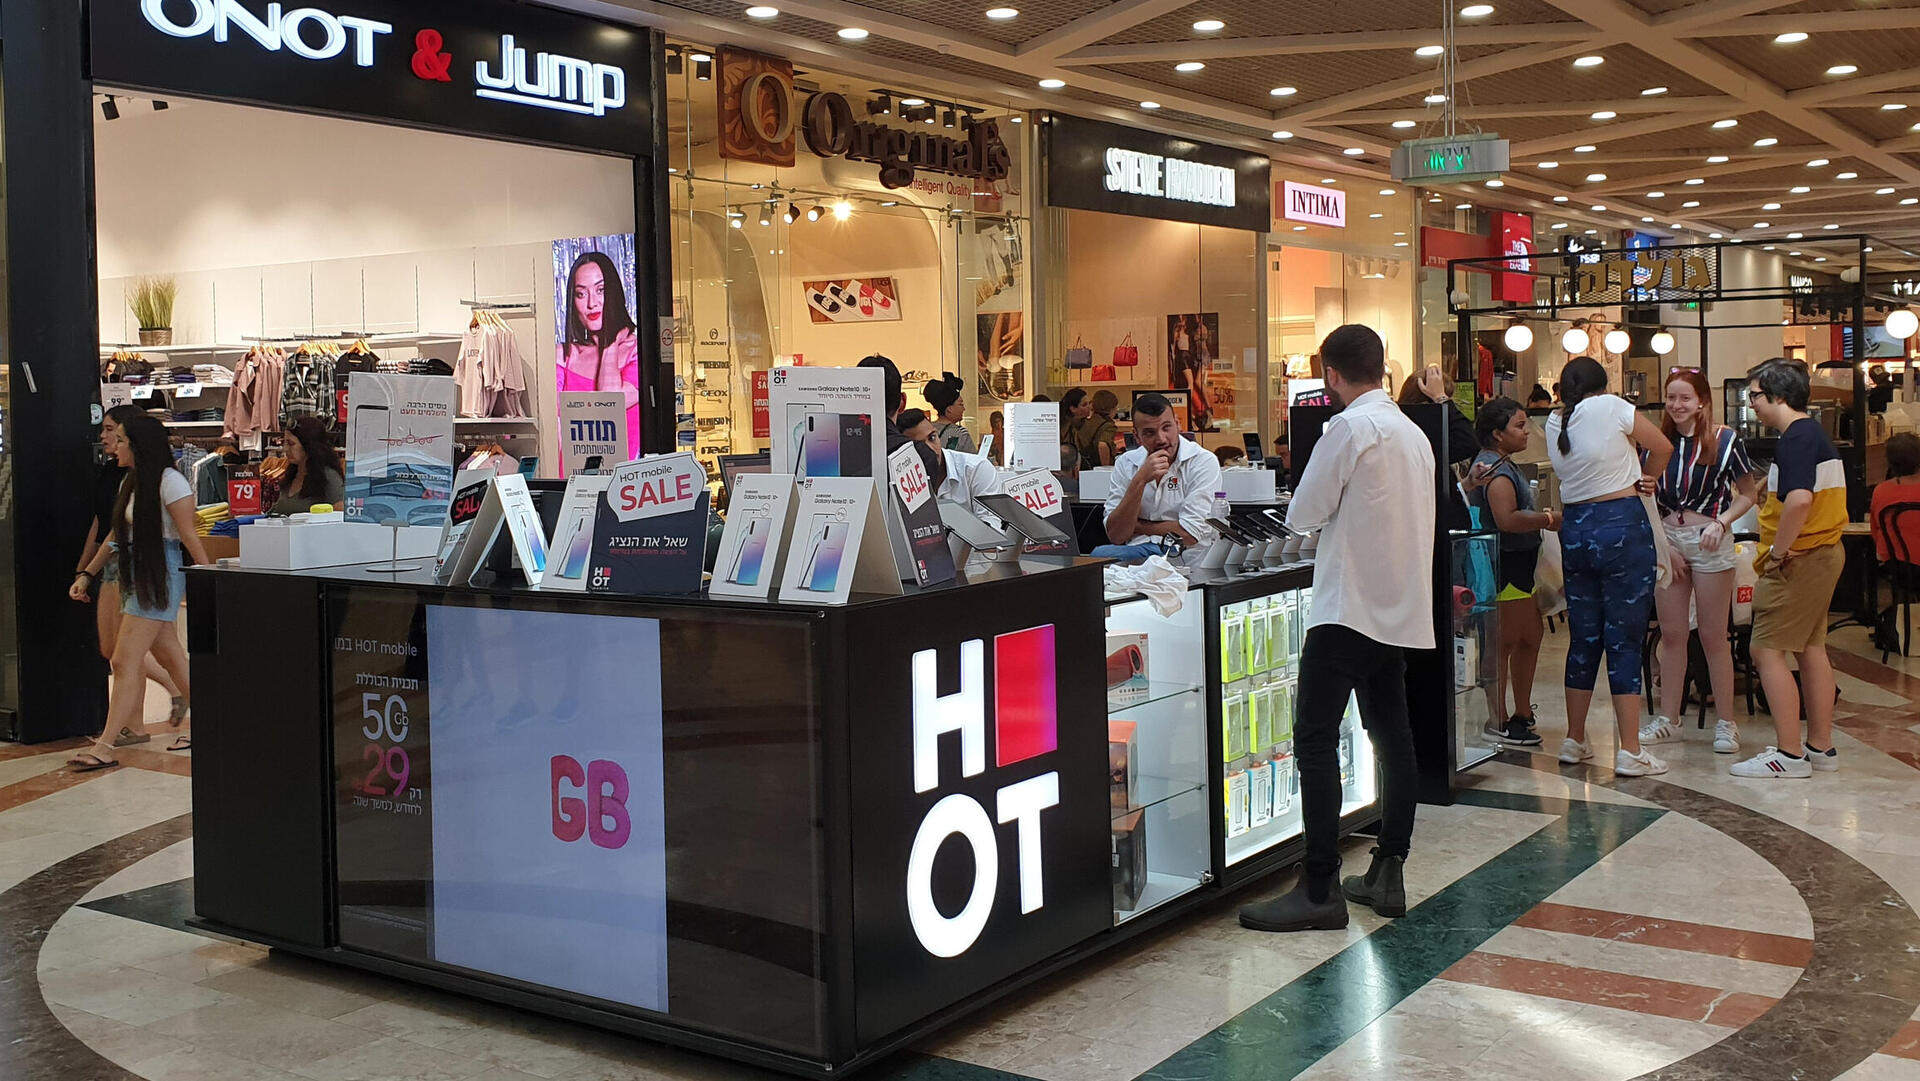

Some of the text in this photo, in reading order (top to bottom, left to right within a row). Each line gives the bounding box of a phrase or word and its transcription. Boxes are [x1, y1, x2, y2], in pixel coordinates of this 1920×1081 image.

[140, 0, 626, 116] ONOT & Jump
[946, 181, 972, 201] Quality
[1103, 147, 1236, 207] STEVE MADDEN
[1291, 189, 1340, 219] INTIMA
[1578, 250, 1711, 296] גולדה
[570, 420, 617, 441] תודה
[574, 444, 616, 456] שהשתתפתן
[619, 471, 639, 482] HOT
[642, 465, 672, 478] mobile
[900, 463, 927, 503] SALE
[1008, 478, 1040, 495] HOT mobile
[619, 474, 694, 511] SALE
[1014, 483, 1058, 511] ALE
[609, 536, 689, 547] שאל את הנציג
[355, 639, 377, 653] HOT
[380, 641, 417, 656] mobile
[362, 692, 408, 743] 50
[363, 743, 422, 800] רק 29
[550, 754, 632, 850] GB
